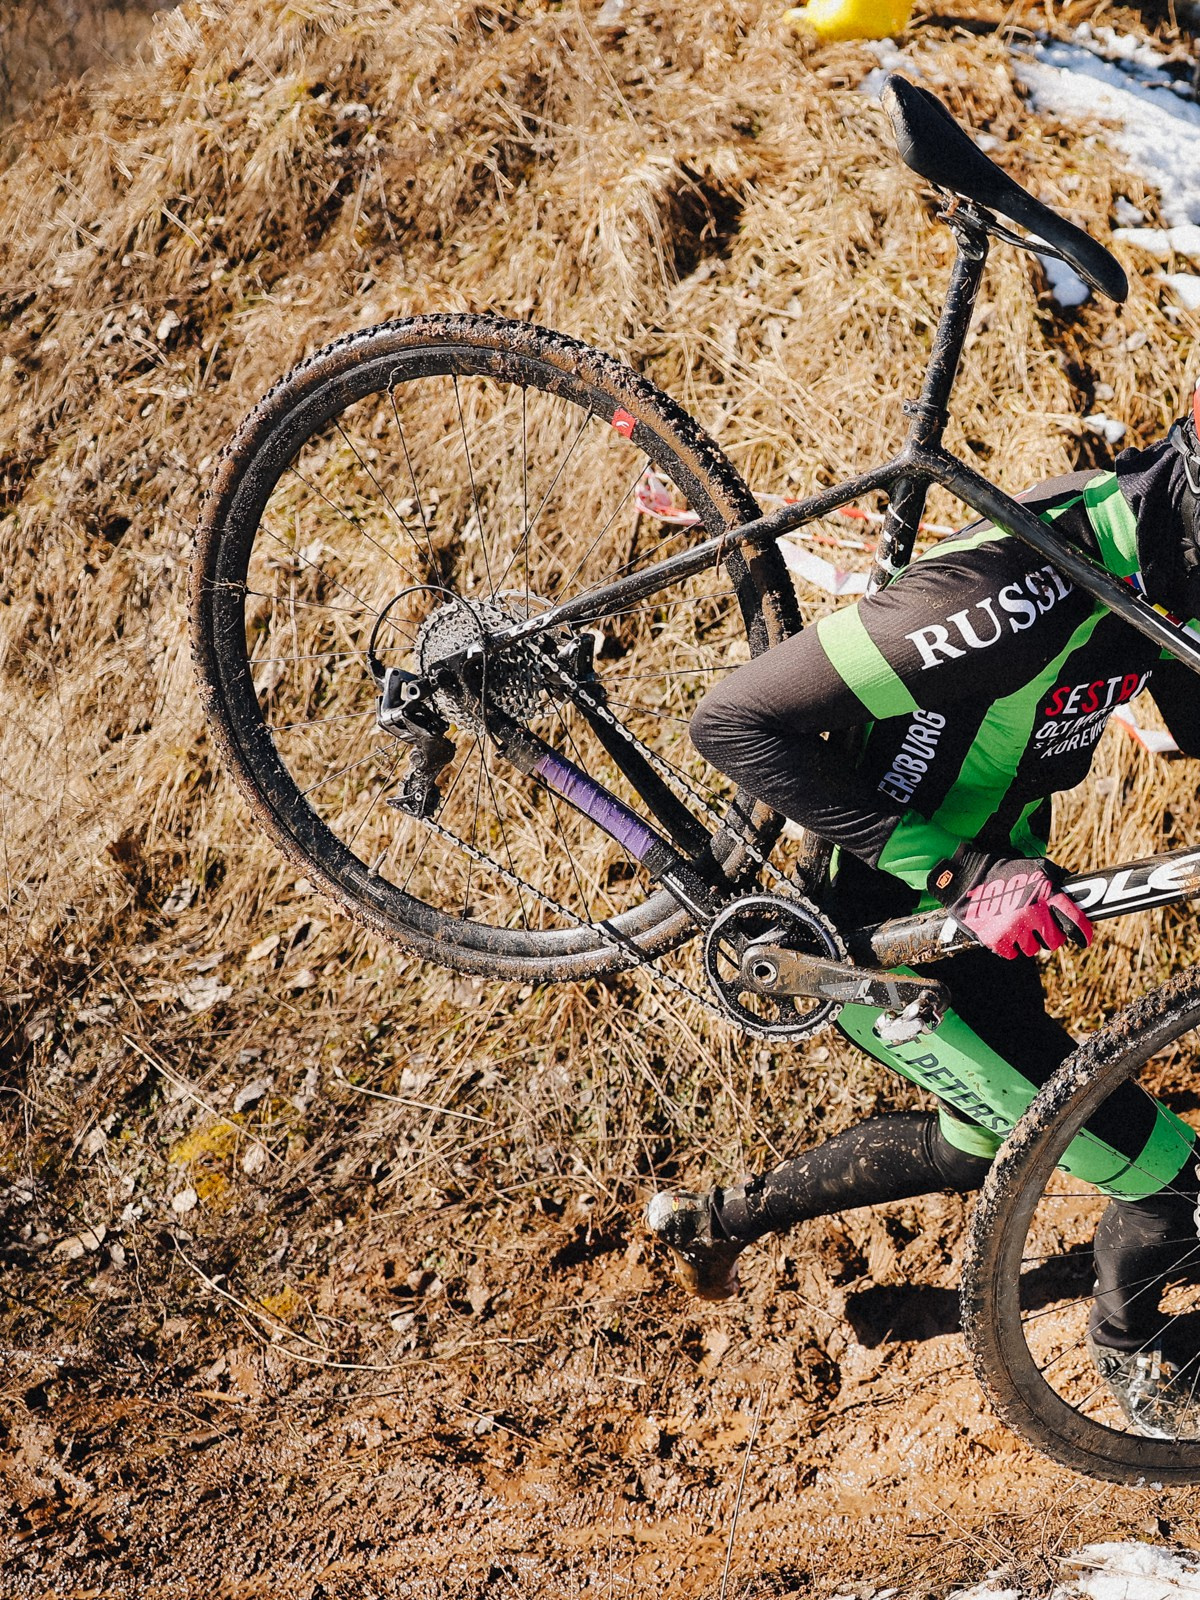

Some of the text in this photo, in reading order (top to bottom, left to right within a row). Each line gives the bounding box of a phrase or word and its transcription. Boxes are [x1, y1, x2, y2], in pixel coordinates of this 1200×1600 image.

[904, 564, 1075, 670] RUSSI
[877, 708, 947, 804] ERSBURG
[966, 870, 1052, 920] 100%
[906, 1052, 1012, 1137] PETERS
